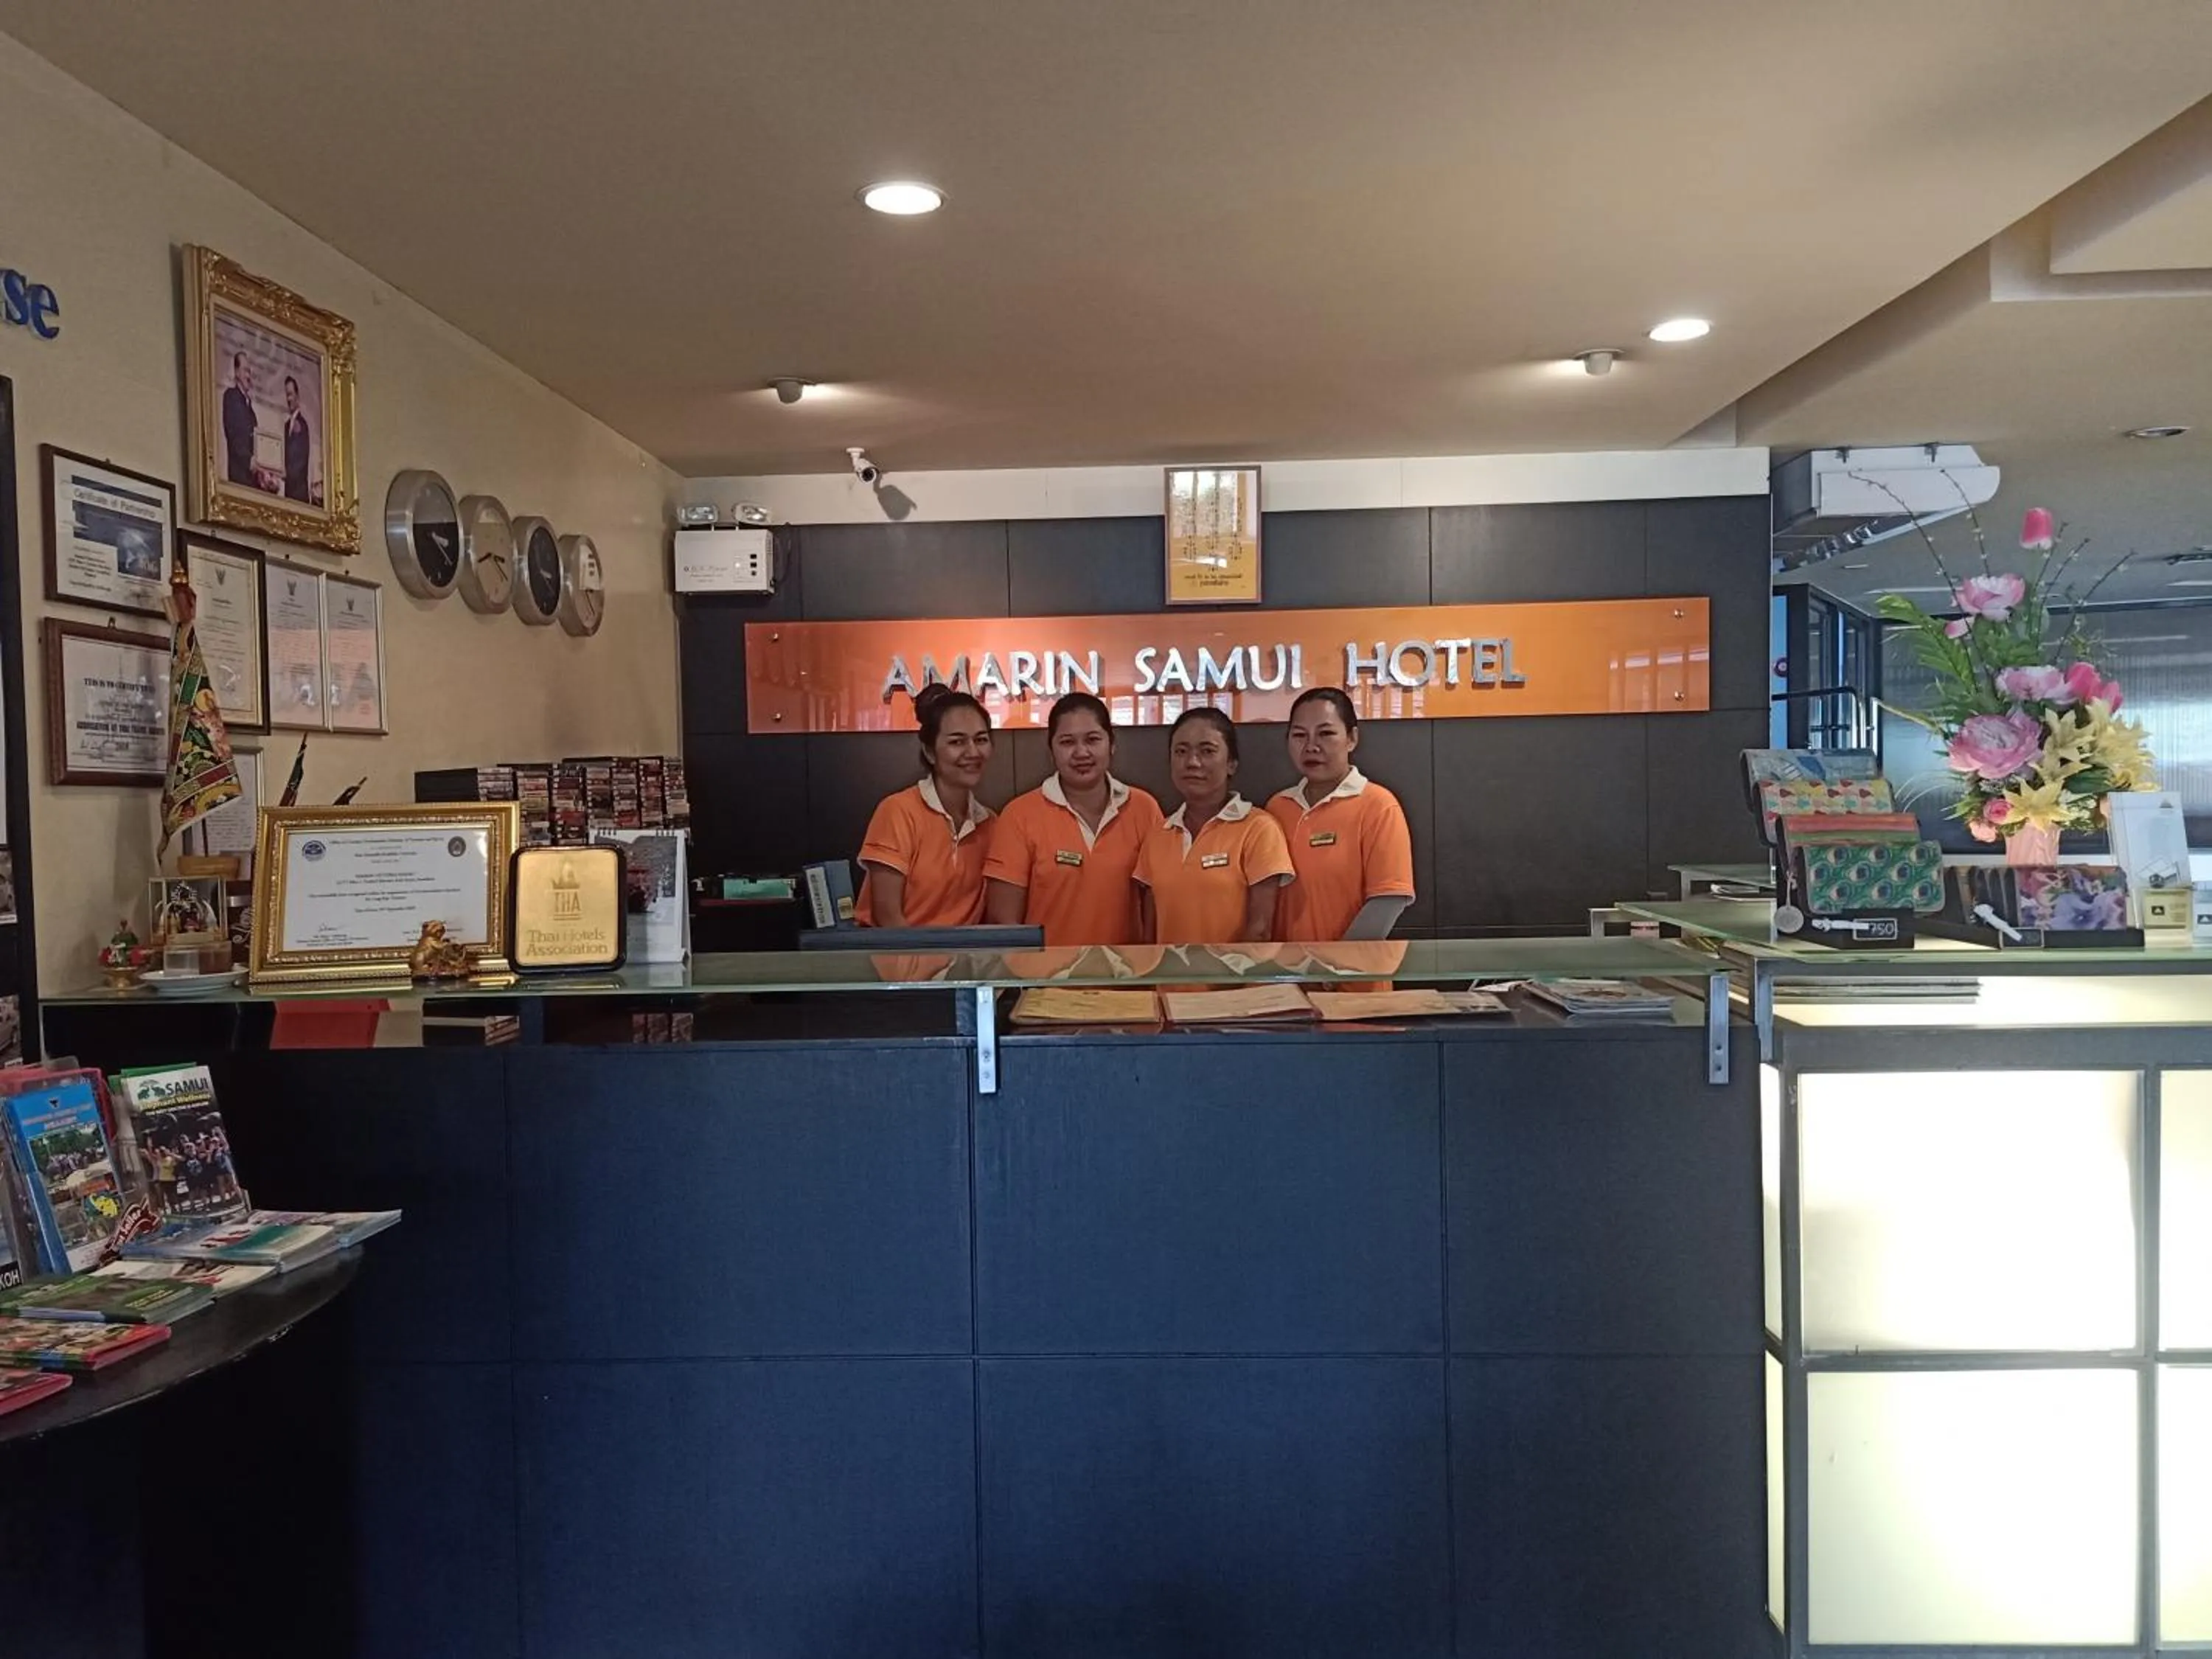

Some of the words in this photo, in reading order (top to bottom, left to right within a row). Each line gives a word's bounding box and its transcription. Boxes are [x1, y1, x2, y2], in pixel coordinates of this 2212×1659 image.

[883, 650, 1099, 699] AMARIN
[1134, 644, 1303, 692] SAMUI
[1345, 637, 1527, 688] HOTEL
[554, 891, 581, 913] THA
[528, 929, 559, 943] Thai
[563, 927, 605, 942] Hotels
[526, 943, 608, 957] Association
[164, 1077, 209, 1096] SAMUI
